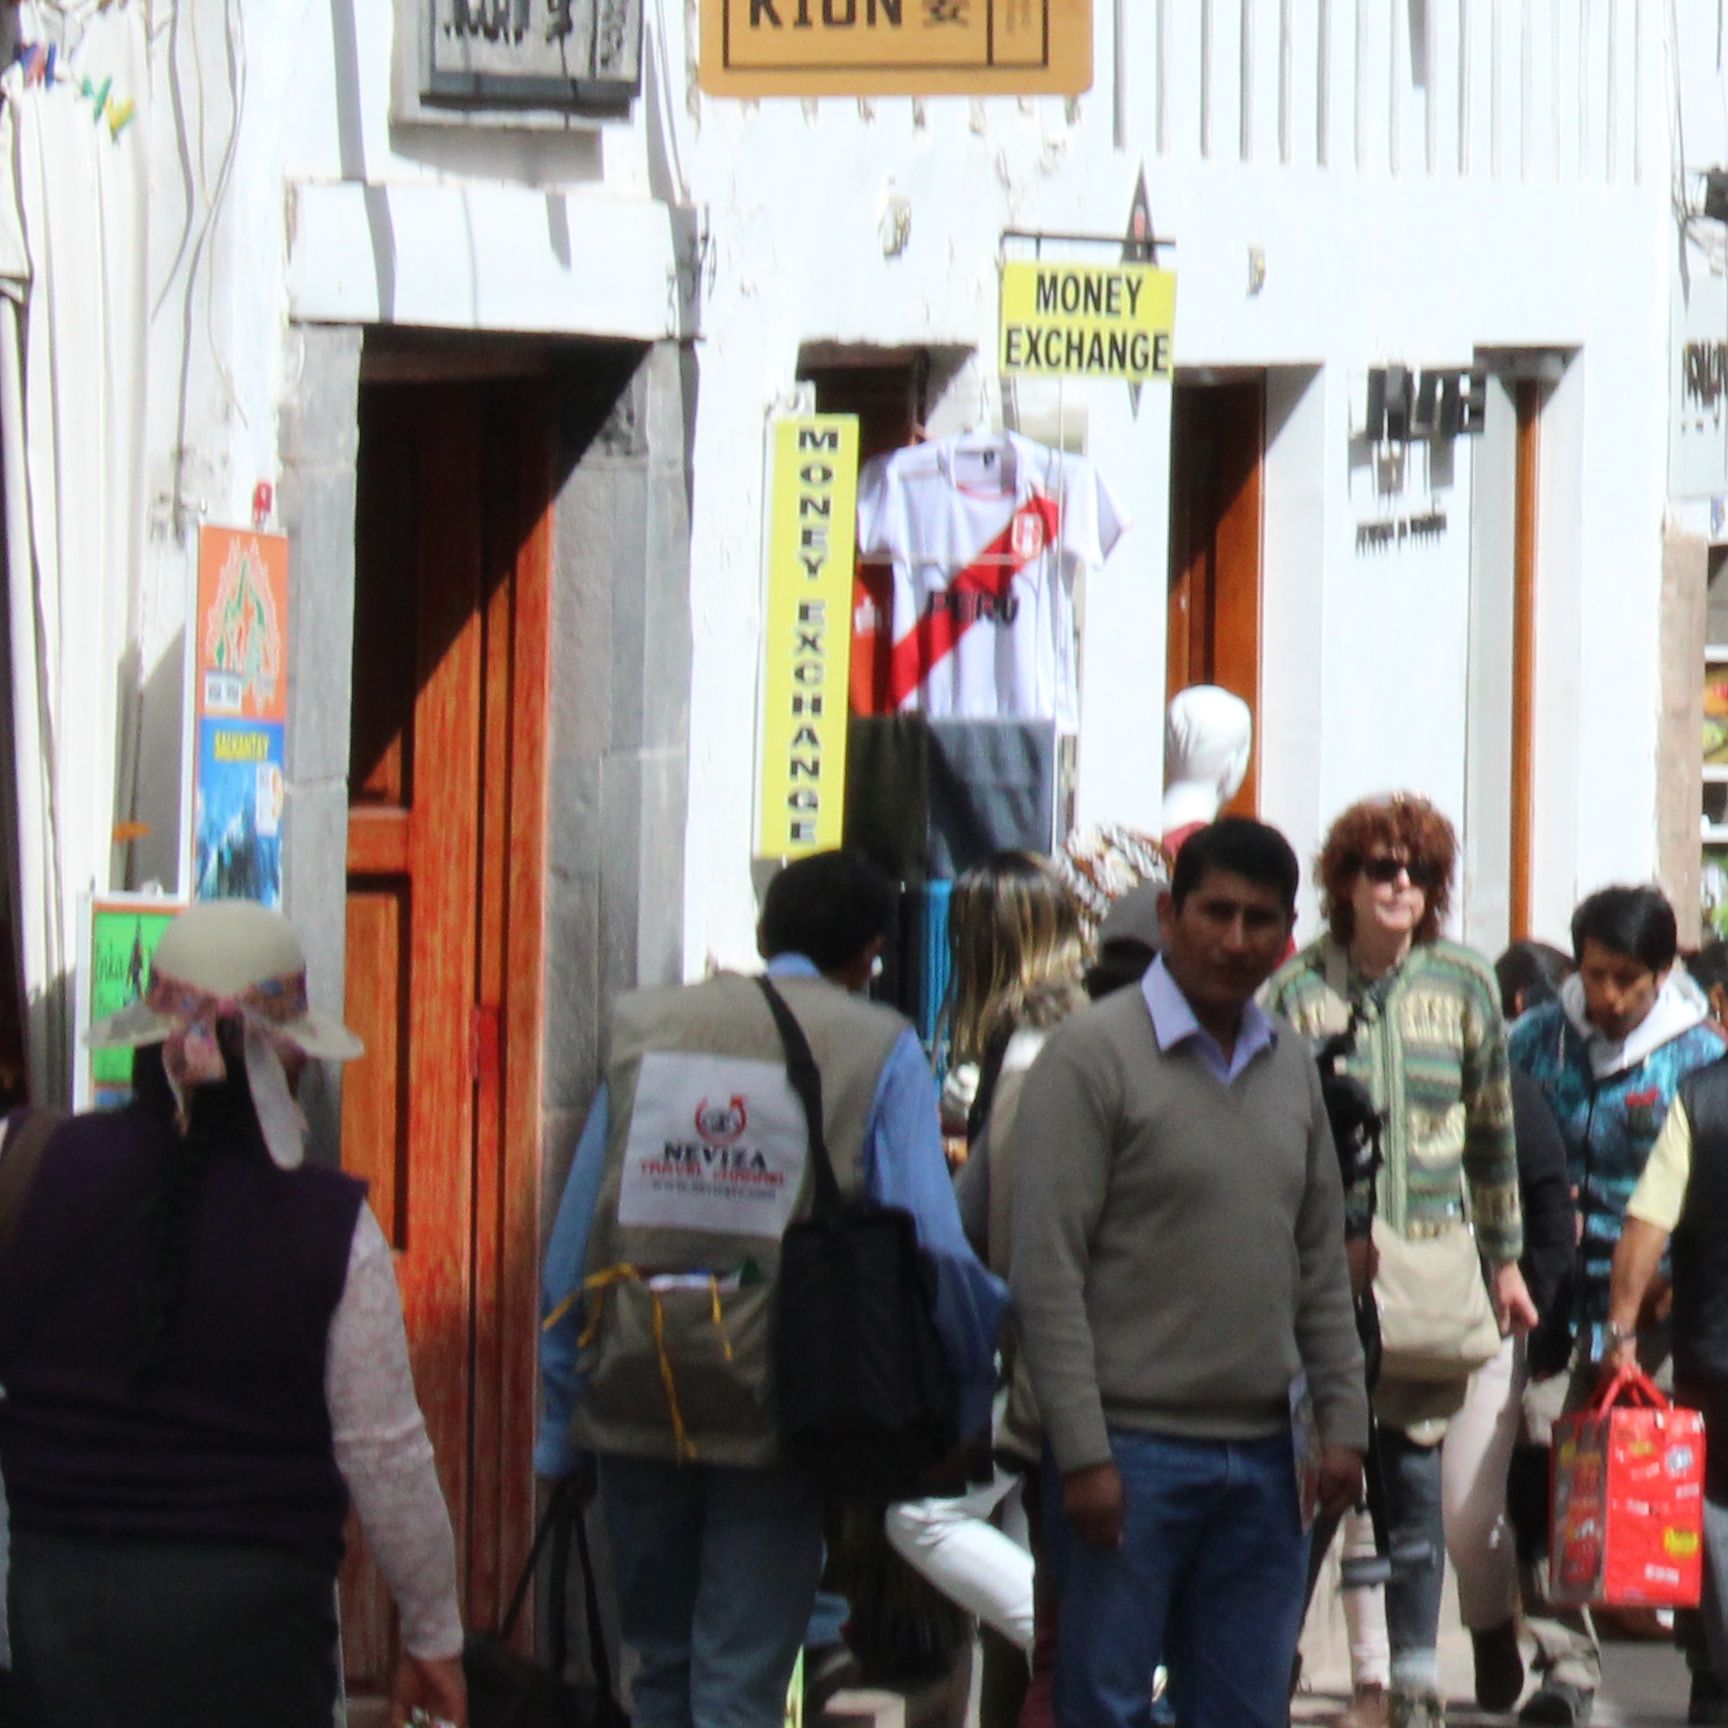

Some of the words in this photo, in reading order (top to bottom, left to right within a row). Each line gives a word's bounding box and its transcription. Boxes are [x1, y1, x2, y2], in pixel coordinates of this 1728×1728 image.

[1035, 273, 1143, 317] MONEY
[1005, 328, 1171, 373] EXCHANGE
[798, 429, 840, 578] MONEY
[787, 602, 825, 844] EXCHANGE
[663, 1139, 769, 1175] NEVIZA
